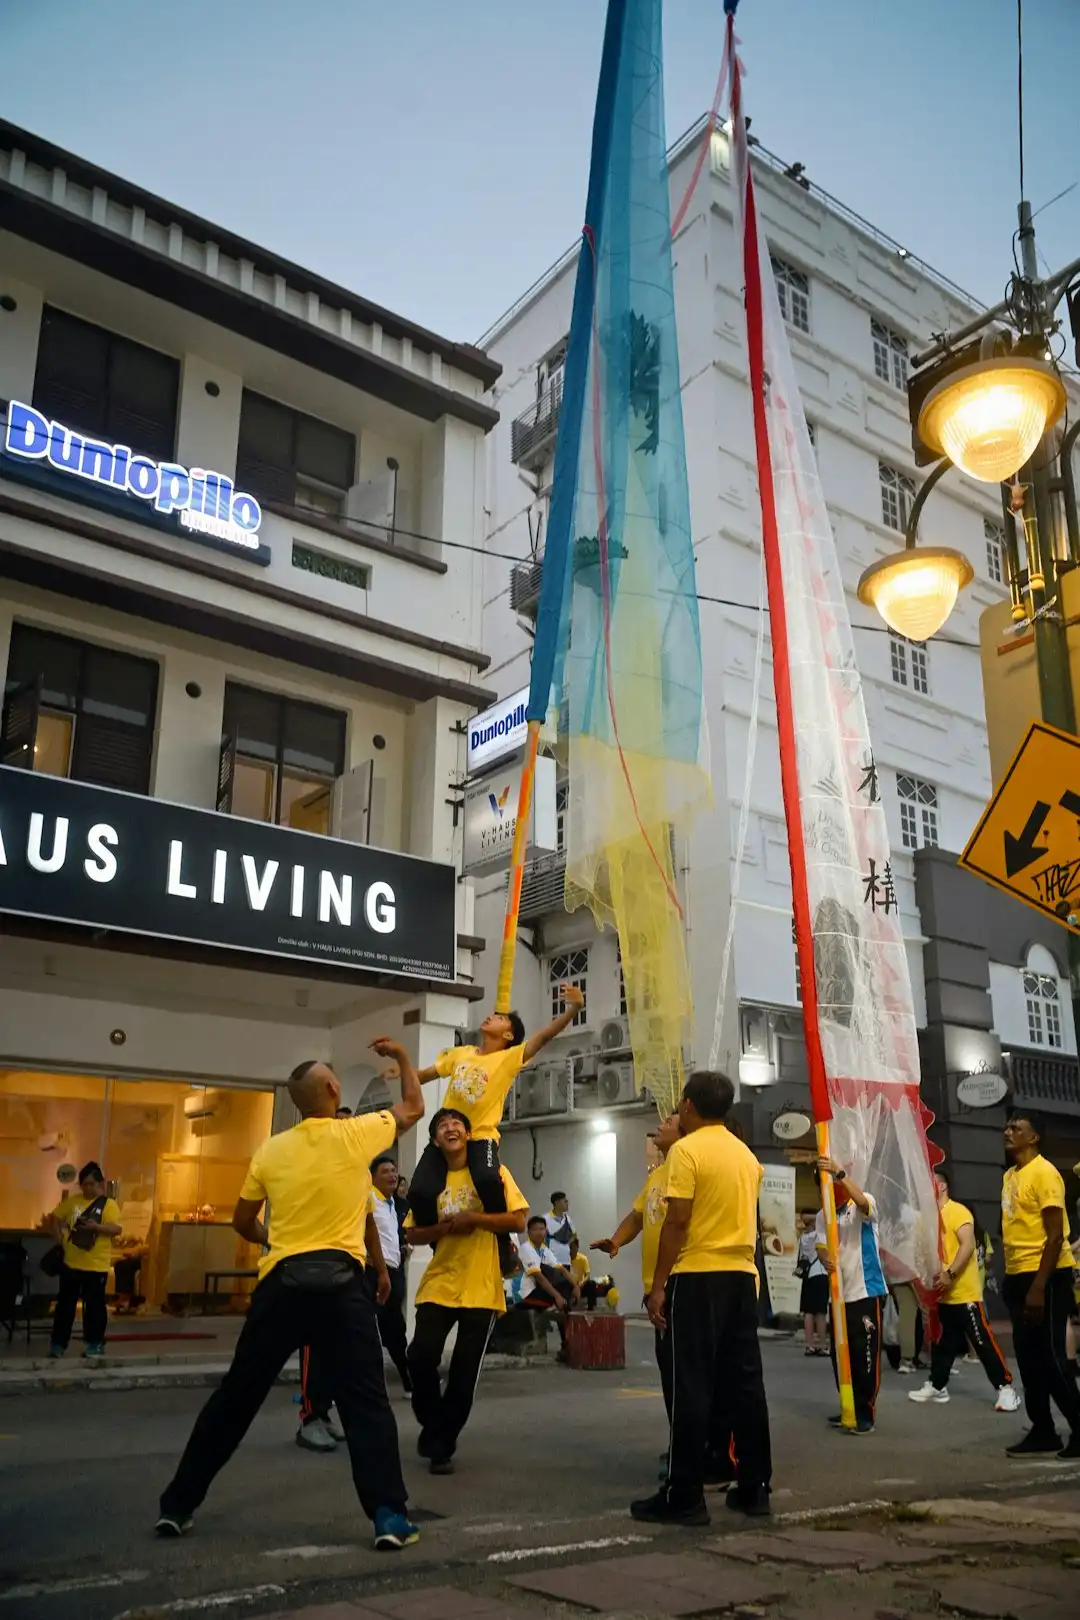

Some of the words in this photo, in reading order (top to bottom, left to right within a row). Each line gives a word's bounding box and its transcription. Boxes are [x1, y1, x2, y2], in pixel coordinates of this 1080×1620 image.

[6, 400, 261, 533] Dunlopillo
[0, 812, 119, 883] US
[167, 840, 396, 934] LIVING
[481, 829, 516, 848] LIVING
